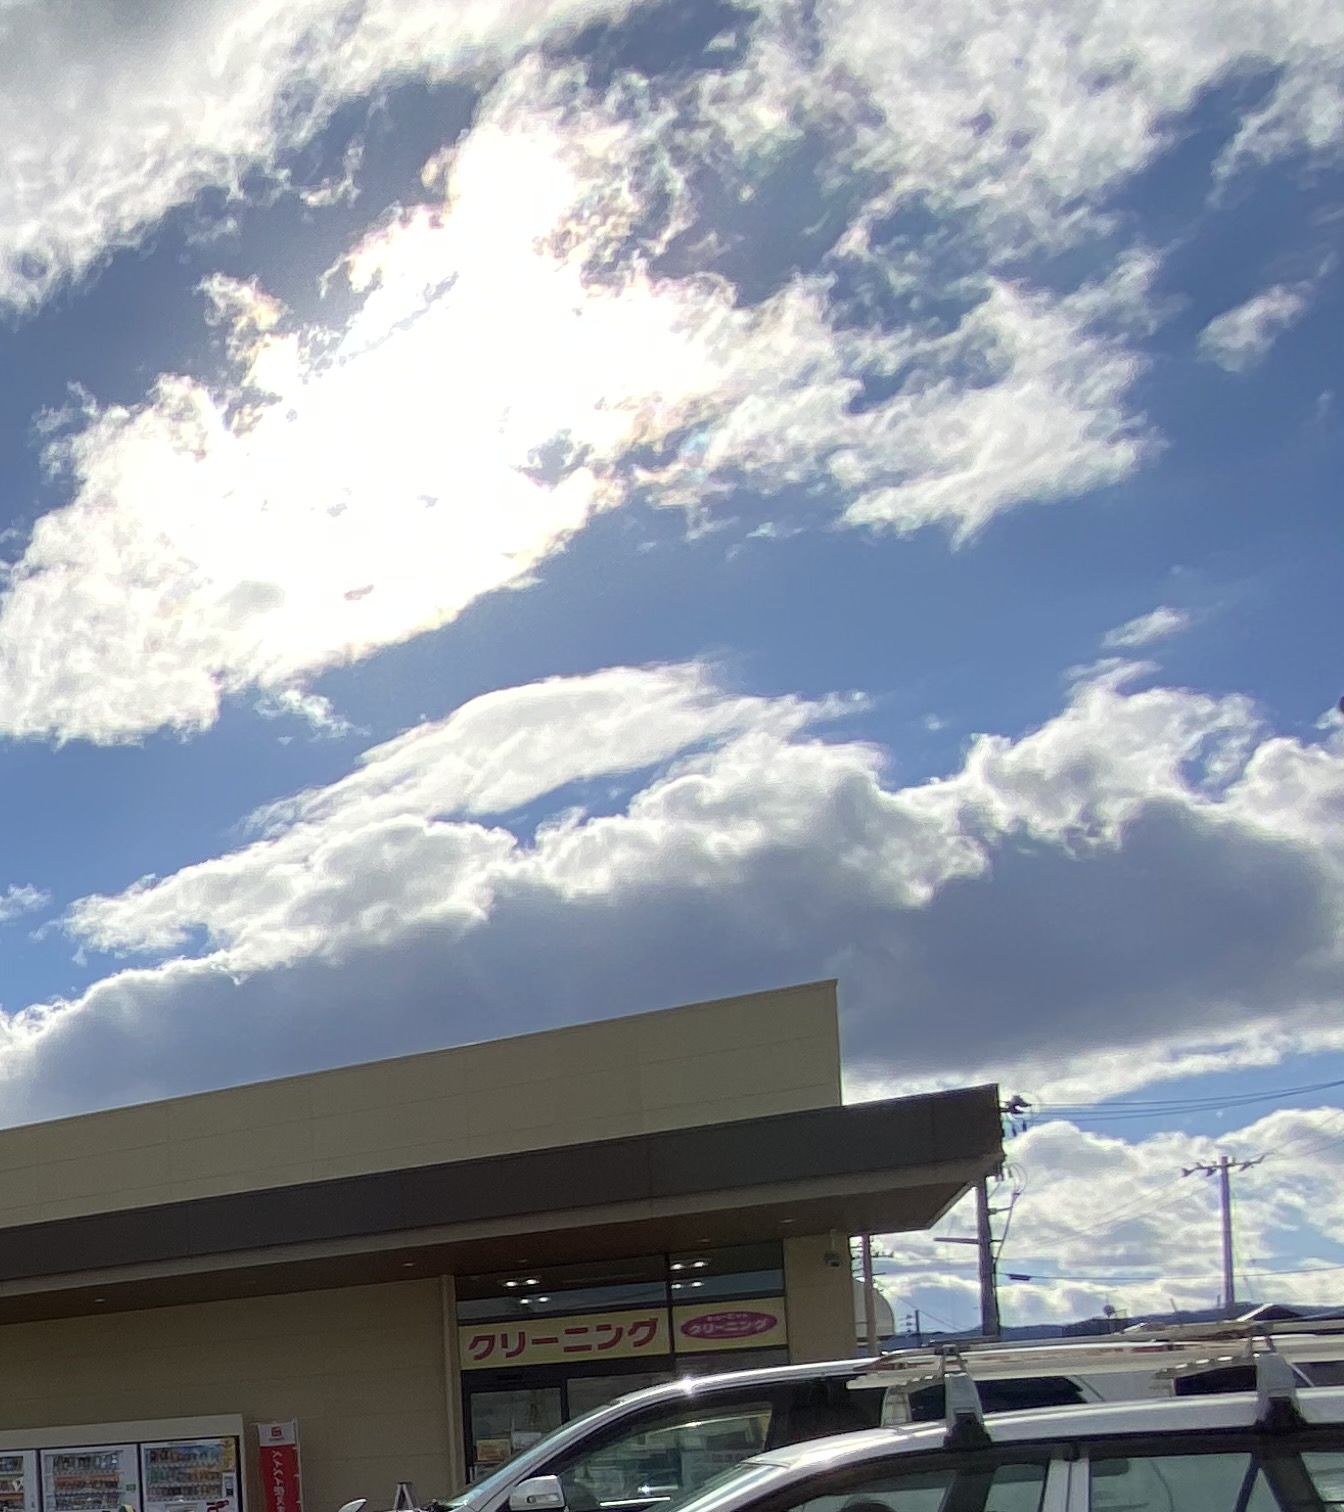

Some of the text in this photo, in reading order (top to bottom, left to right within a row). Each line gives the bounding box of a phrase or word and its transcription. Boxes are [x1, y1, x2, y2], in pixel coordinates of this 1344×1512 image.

[468, 1317, 659, 1361] クリーニング
